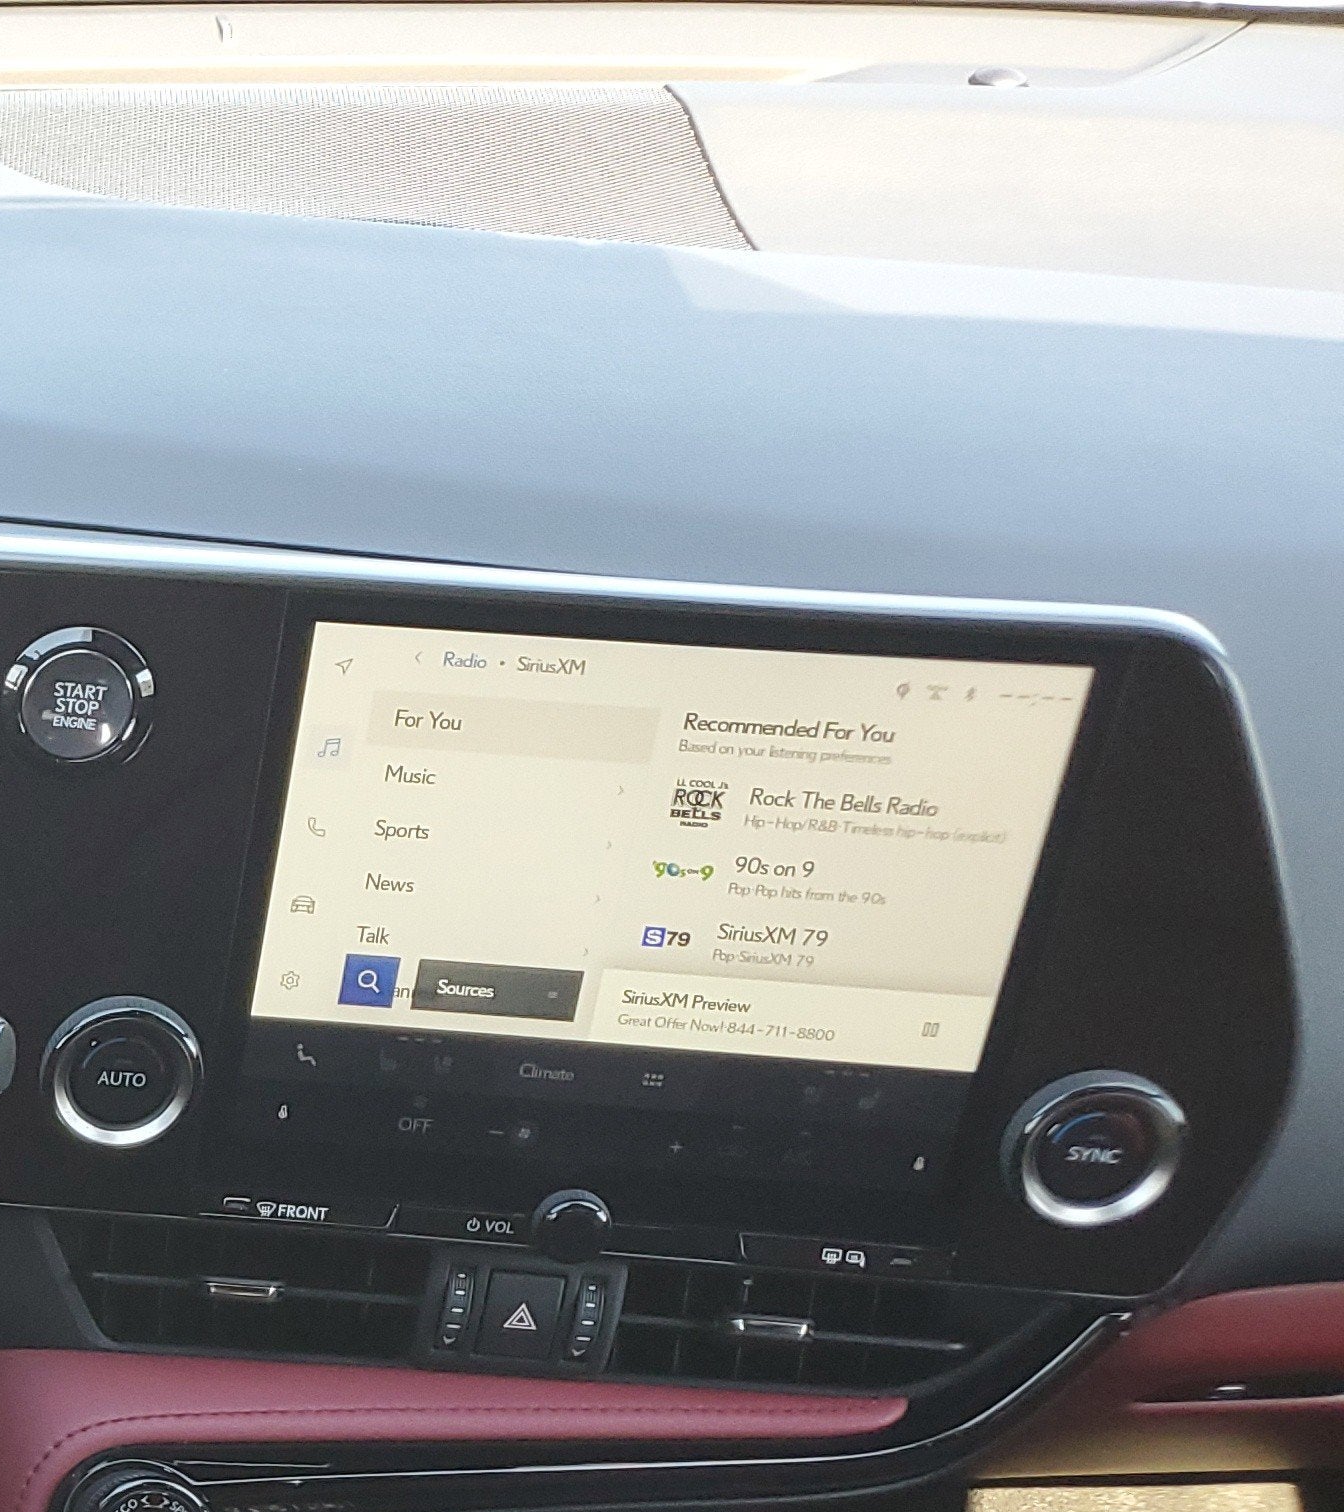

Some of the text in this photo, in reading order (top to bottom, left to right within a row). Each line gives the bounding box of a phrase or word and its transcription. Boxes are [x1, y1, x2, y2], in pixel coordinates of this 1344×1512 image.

[443, 651, 586, 676] Radio SiriusXM
[53, 681, 108, 701] START
[55, 698, 100, 715] STOP
[53, 715, 97, 730] ENGINE
[394, 709, 462, 731] For You
[683, 712, 895, 743] Recommended For You
[678, 739, 717, 754] Based
[719, 744, 734, 755] on
[737, 746, 765, 758] your
[769, 744, 819, 762] listening
[384, 764, 436, 785] Music
[689, 779, 716, 789] COOL
[672, 788, 726, 809] ROCK
[749, 787, 939, 818] Rock The Bells Radio
[374, 820, 430, 841] Sports
[735, 856, 815, 878] 90s on 9
[365, 872, 415, 893] News
[781, 885, 802, 899] hits
[805, 887, 834, 901] from
[838, 889, 857, 903] the
[862, 892, 886, 905] 90s
[356, 925, 390, 945] Talk
[717, 923, 829, 947] SiriusXM 79
[796, 954, 815, 968] 79
[437, 978, 495, 998] Sources
[621, 989, 751, 1013] SiriusXM Preview
[617, 1013, 651, 1028] Great
[654, 1016, 687, 1031] Offer
[97, 1071, 146, 1087] AUTO
[519, 1063, 576, 1081] Climate
[398, 1117, 435, 1134] OFF
[1064, 1146, 1123, 1164] SYNC
[277, 1204, 329, 1222] FRONT
[485, 1220, 514, 1234] VOL
